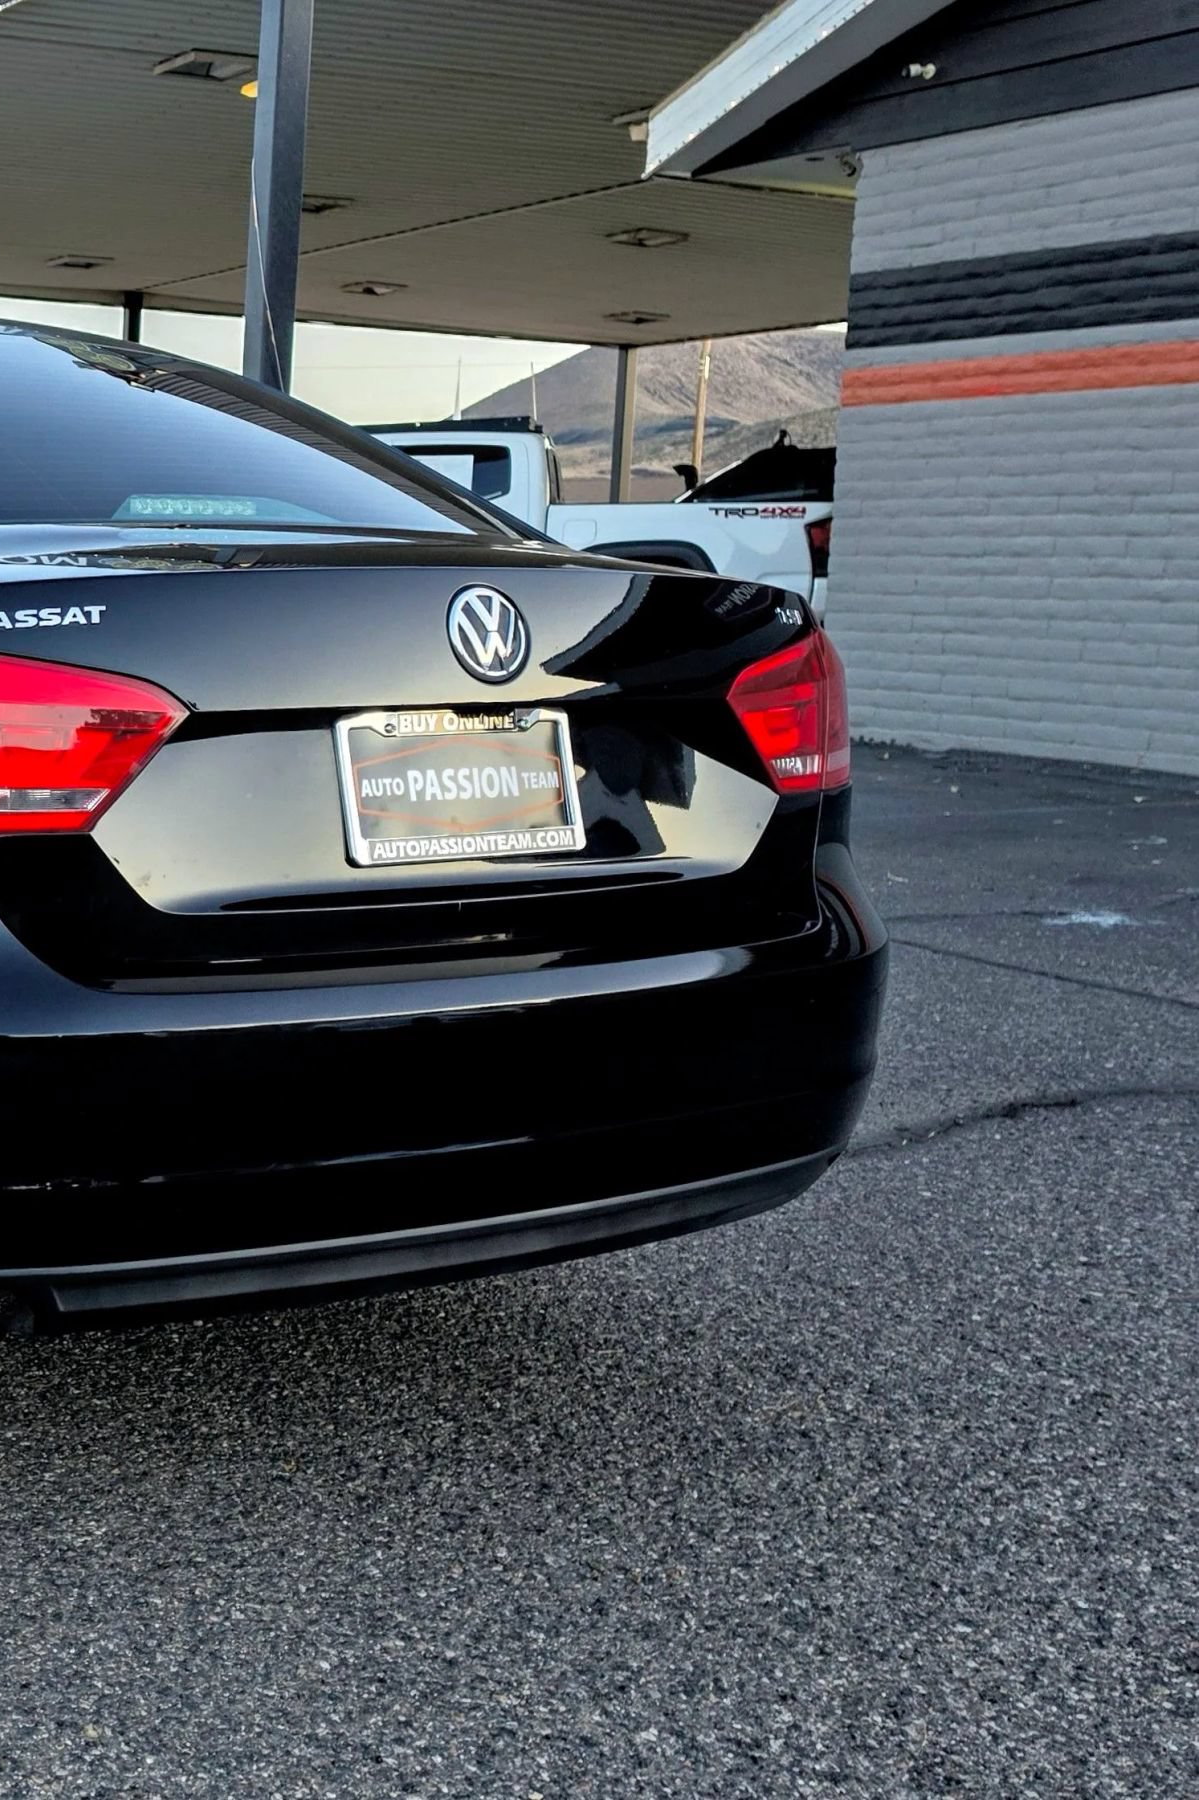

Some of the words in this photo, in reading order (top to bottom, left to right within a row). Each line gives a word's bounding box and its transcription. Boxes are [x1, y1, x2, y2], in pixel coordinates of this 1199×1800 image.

[400, 714, 437, 733] BUY
[443, 711, 516, 732] ONLINE
[361, 777, 404, 798] AUTO
[407, 766, 520, 801] PASSION
[521, 771, 560, 789] TEAM
[373, 829, 575, 859] AUTOPASSIONTEAM.COM
